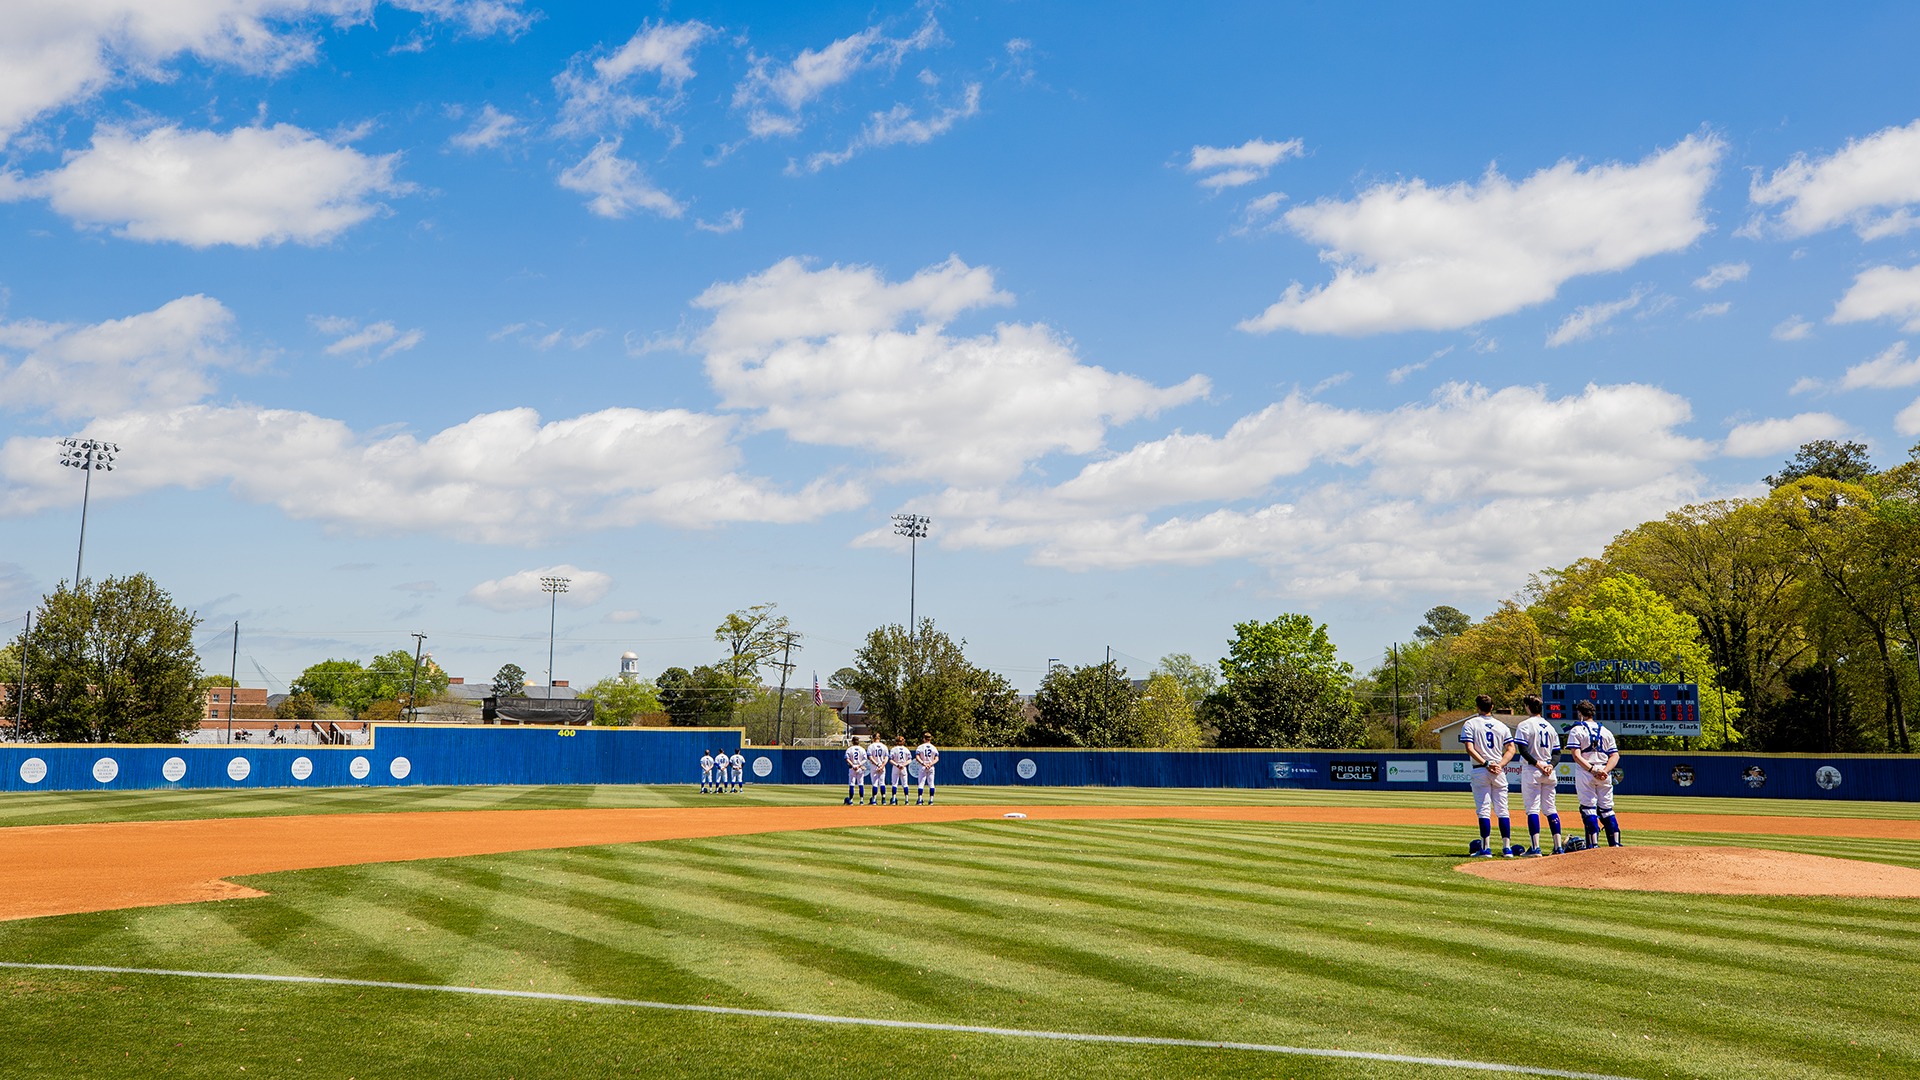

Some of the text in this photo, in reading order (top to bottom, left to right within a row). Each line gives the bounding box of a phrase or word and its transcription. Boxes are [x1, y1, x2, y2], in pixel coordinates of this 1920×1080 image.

[1574, 659, 1661, 675] CAPTAINS
[557, 729, 576, 737] 400
[1485, 732, 1494, 749] 9
[1539, 731, 1549, 748] 11
[853, 751, 859, 761] 2
[875, 749, 883, 757] 10
[899, 751, 904, 760] 3
[924, 749, 932, 758] 12
[1331, 765, 1377, 773] PRIORITY
[1336, 772, 1373, 780] LEXUS
